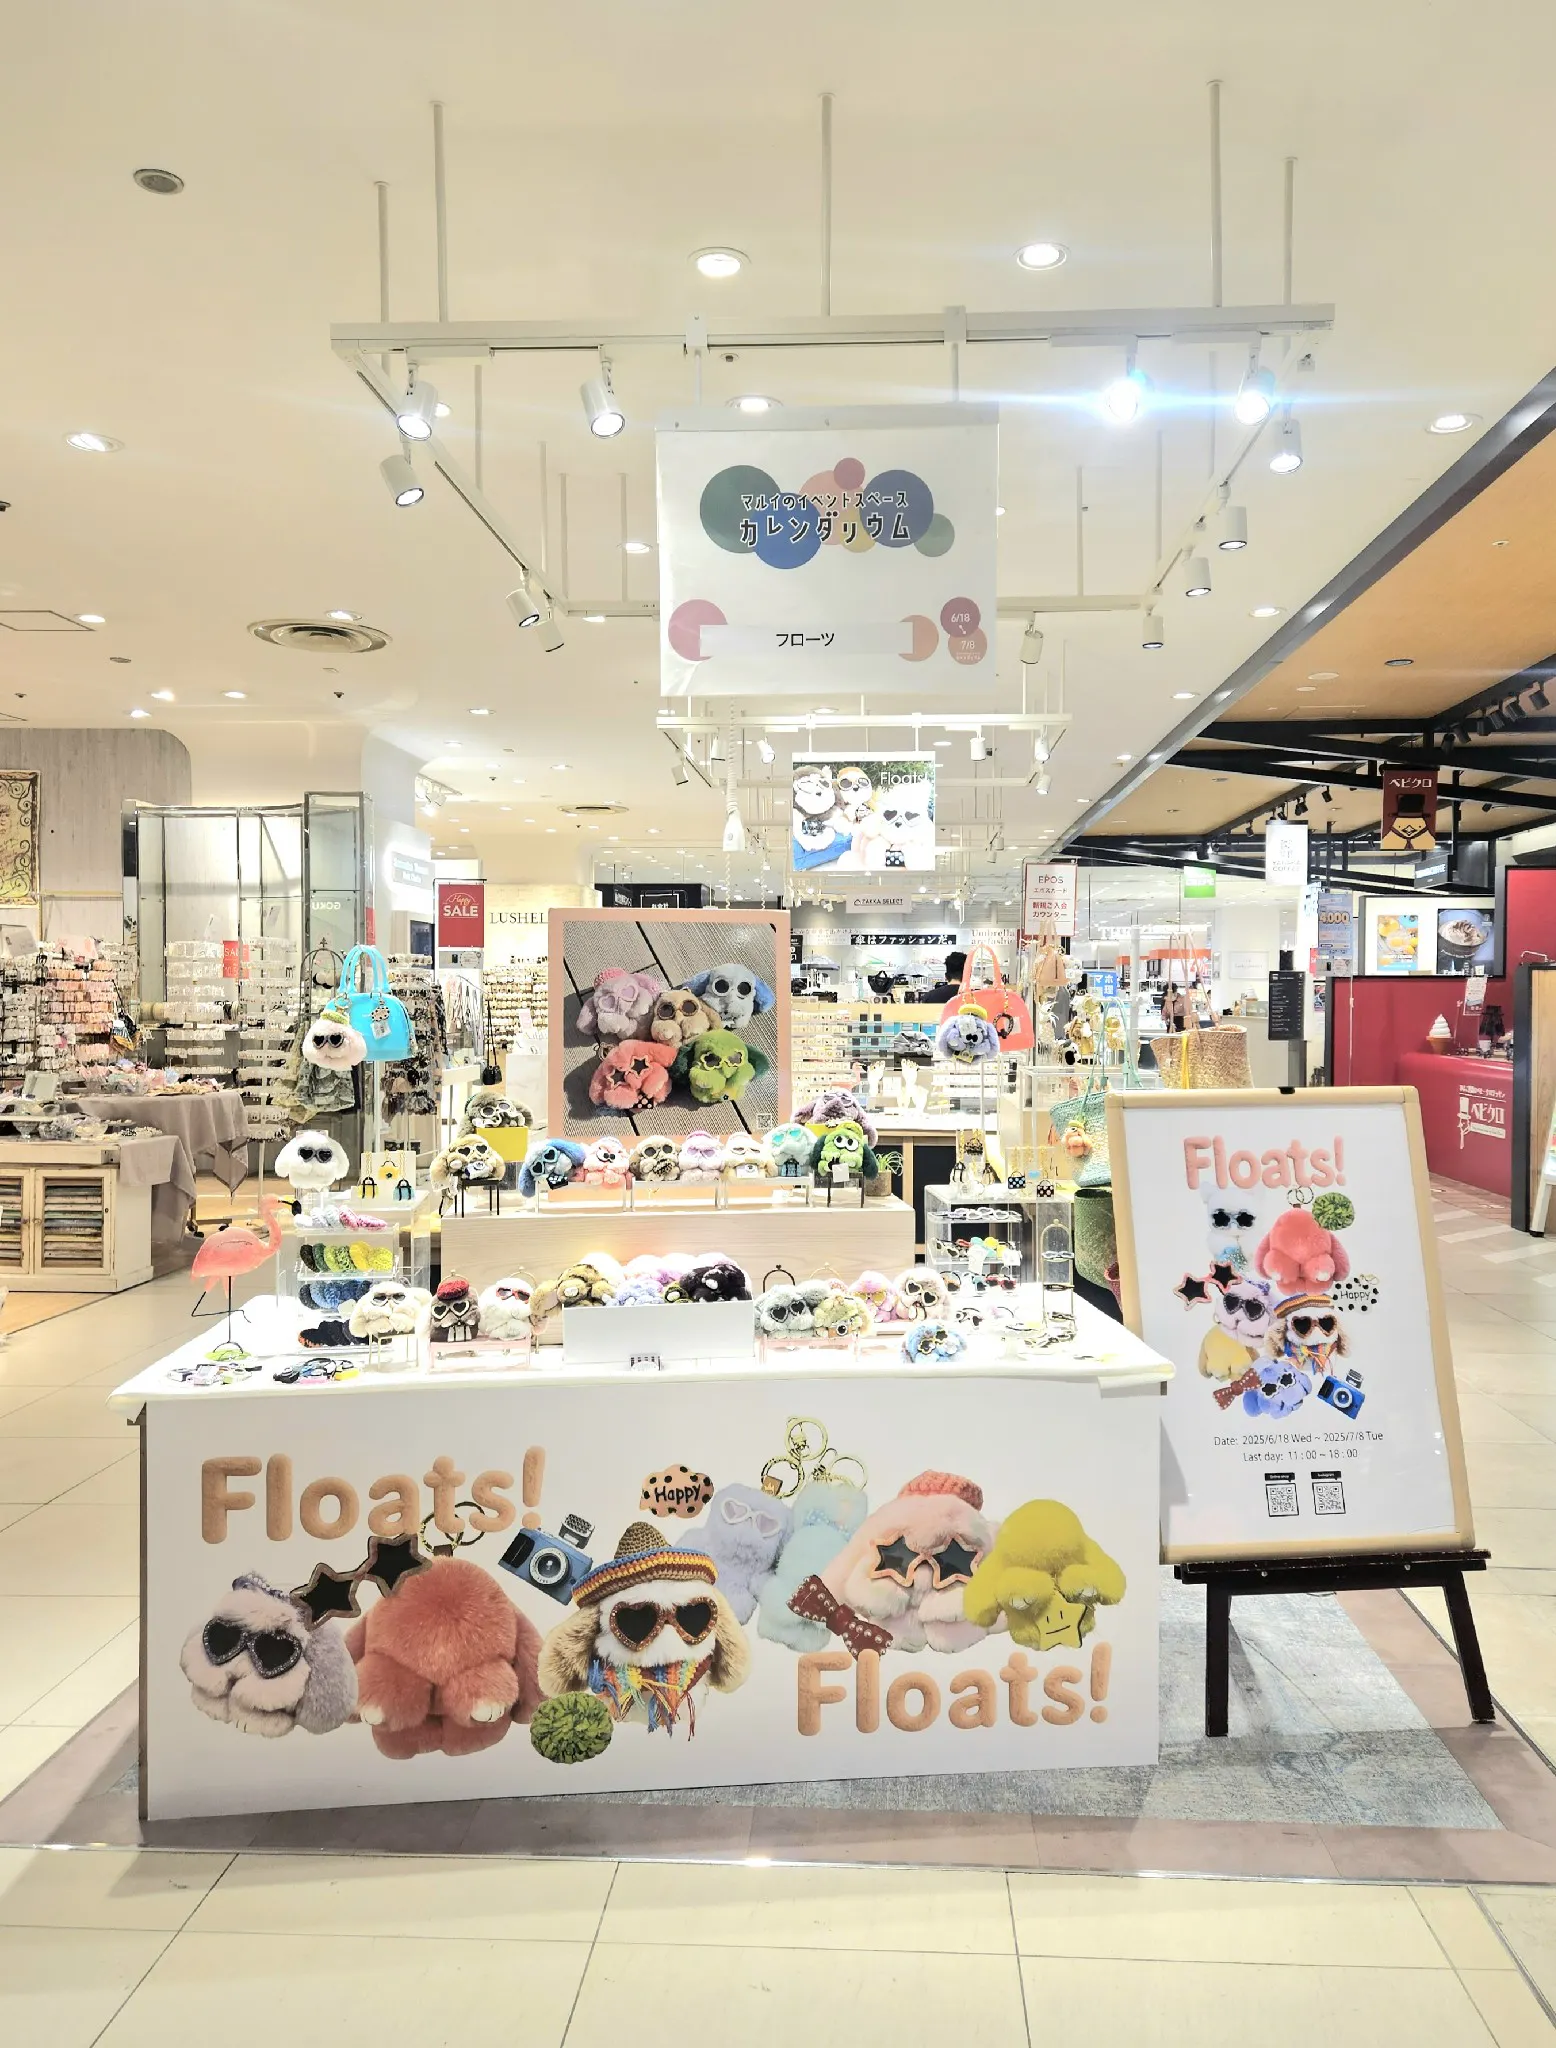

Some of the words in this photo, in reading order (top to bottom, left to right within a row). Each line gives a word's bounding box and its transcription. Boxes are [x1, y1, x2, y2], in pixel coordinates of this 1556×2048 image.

[741, 491, 909, 511] マルイのイベントスペース
[739, 511, 911, 547] カレンダリウム
[951, 613, 970, 623] 6/18
[776, 632, 835, 646] フローツ
[961, 640, 975, 650] 7/8
[1038, 874, 1064, 884] EPOS
[449, 894, 471, 906] Happy
[443, 905, 479, 917] SALE
[971, 929, 1015, 937] Umbrella
[1183, 1135, 1346, 1190] Floats!
[1340, 1290, 1371, 1301] Happy
[1214, 1436, 1238, 1446] Date:
[1243, 1434, 1289, 1445] 2025/6/18
[1291, 1433, 1312, 1443] Wed
[1324, 1432, 1365, 1442] 2025/7/8
[1366, 1430, 1384, 1440] Tue
[1243, 1452, 1262, 1462] Last
[1264, 1451, 1284, 1463] day:
[201, 1445, 546, 1544] Floats!
[654, 1484, 701, 1505] Happy
[797, 1641, 1113, 1737] Floats!
